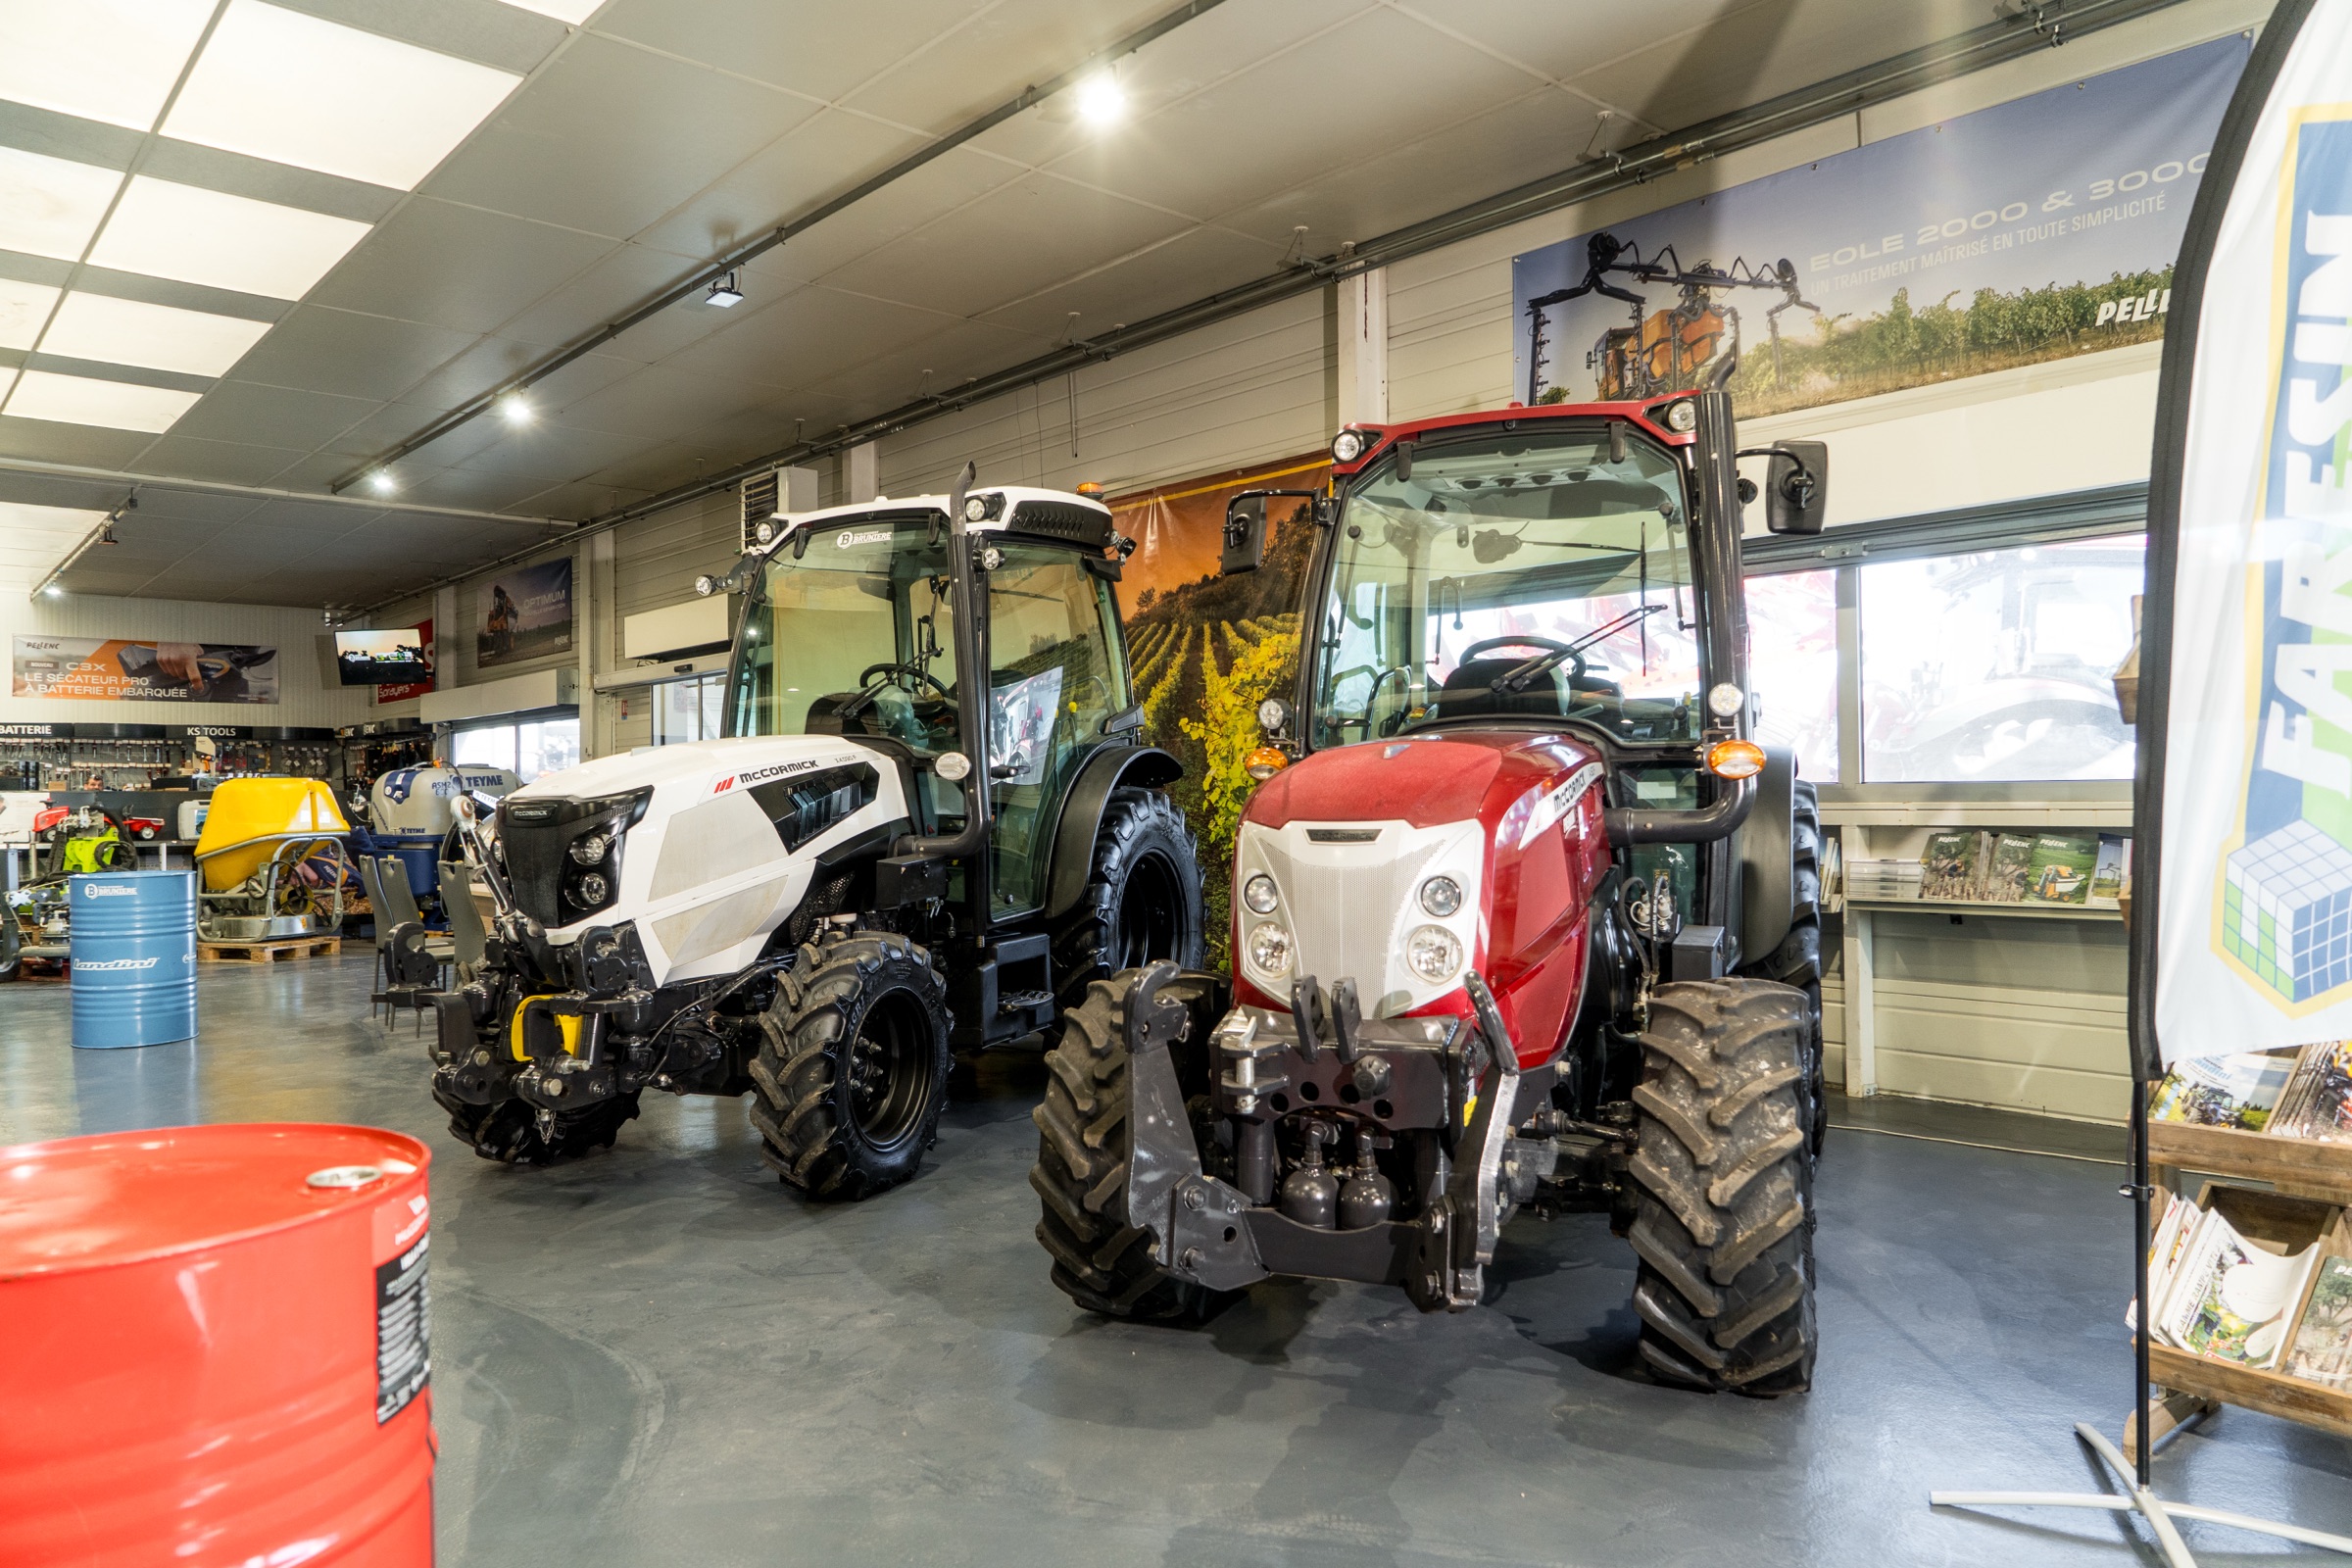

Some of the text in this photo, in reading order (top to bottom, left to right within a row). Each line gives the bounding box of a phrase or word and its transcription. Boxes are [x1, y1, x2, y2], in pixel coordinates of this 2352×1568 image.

[1809, 233, 1904, 272] EOLE
[1916, 201, 2029, 245] 2000
[2041, 190, 2076, 213] &
[1810, 190, 2167, 297] UN TRAITEMENT MAÎTRISÉ EN TOUTE SIMPLICITÉ
[523, 589, 565, 610] OPTIMUM
[26, 641, 61, 651] PELLENC
[66, 662, 107, 671] C3X
[24, 671, 149, 687] LE SÉCATEUR PRO
[24, 682, 188, 699] À BATTERIE EMBARQUÉE
[378, 686, 410, 699] Sprayers
[0, 725, 52, 736] BATTERIE
[187, 726, 236, 737] KS TOOLS
[465, 774, 504, 787] TEYME
[2333, 1264, 2352, 1278] PE
